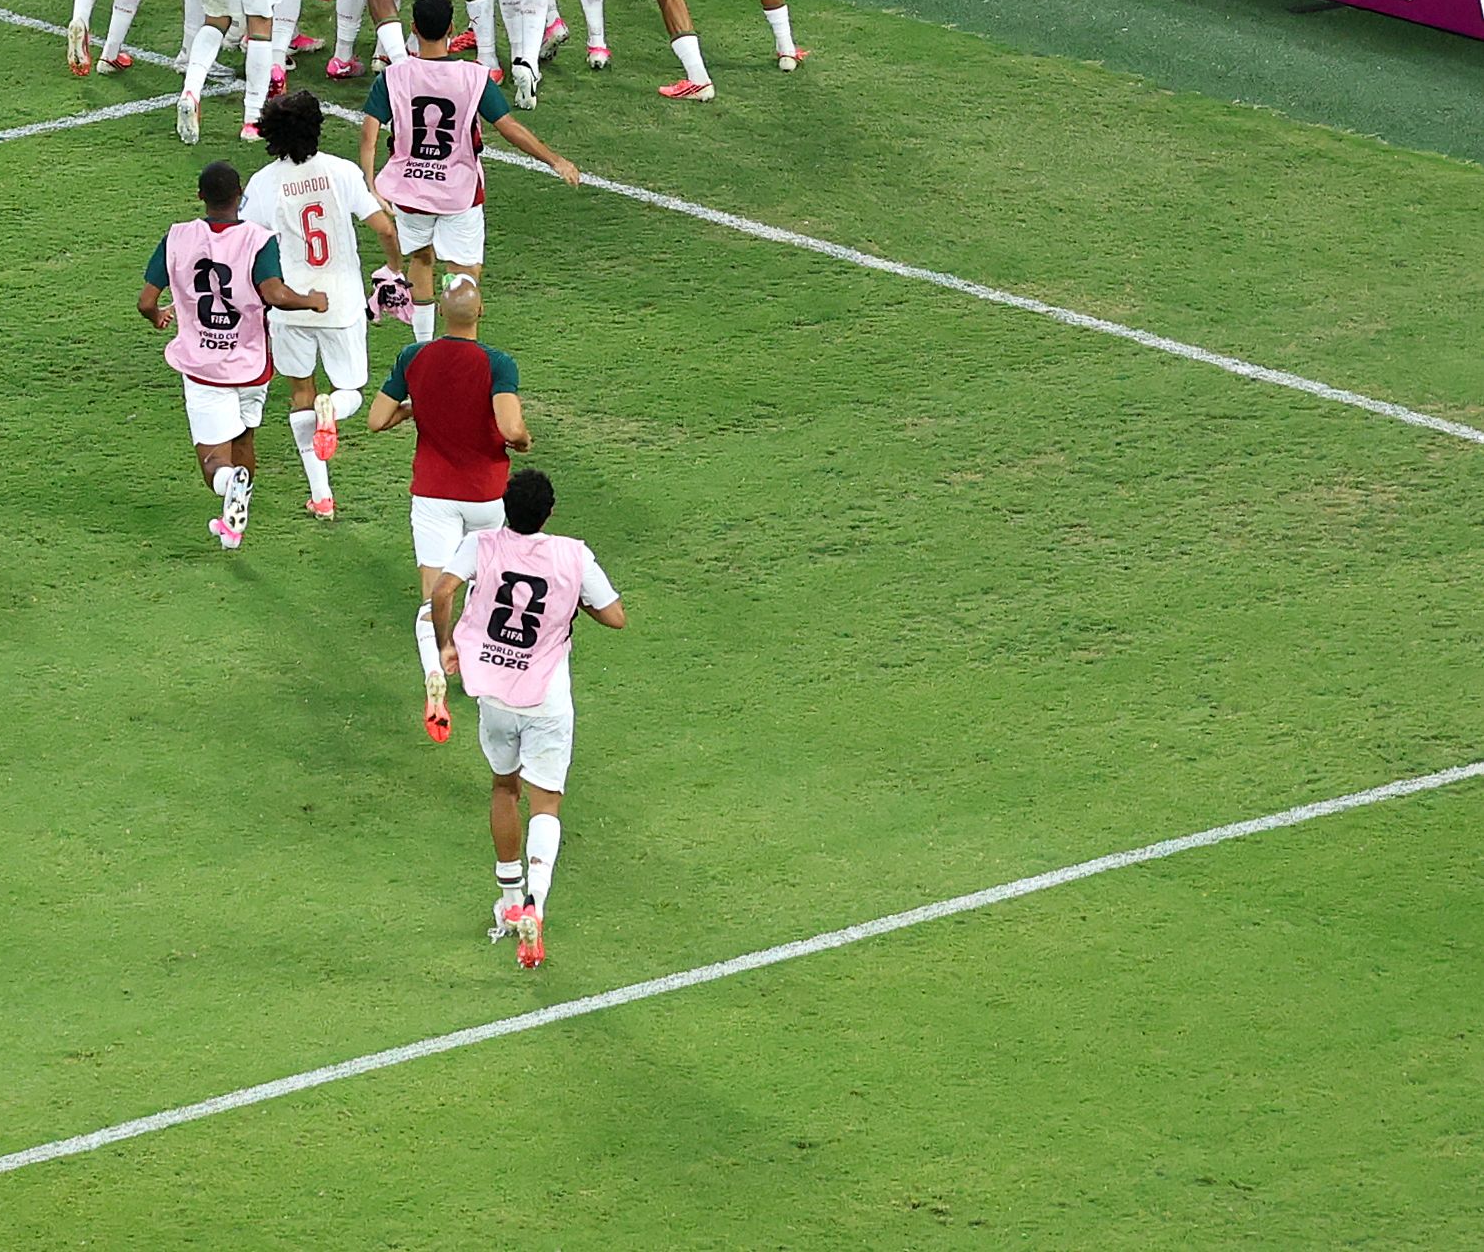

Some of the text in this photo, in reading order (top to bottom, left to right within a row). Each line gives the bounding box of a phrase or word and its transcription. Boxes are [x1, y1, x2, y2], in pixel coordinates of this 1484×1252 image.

[419, 146, 441, 157] FIFA
[406, 160, 448, 170] WORLD CUP
[403, 168, 447, 182] 2026
[283, 176, 330, 197] BOUADDI
[299, 201, 330, 268] 6
[211, 314, 231, 325] FIFA
[500, 628, 523, 643] FIFA
[482, 642, 532, 660] WORLD CUP
[479, 651, 530, 672] 2026
